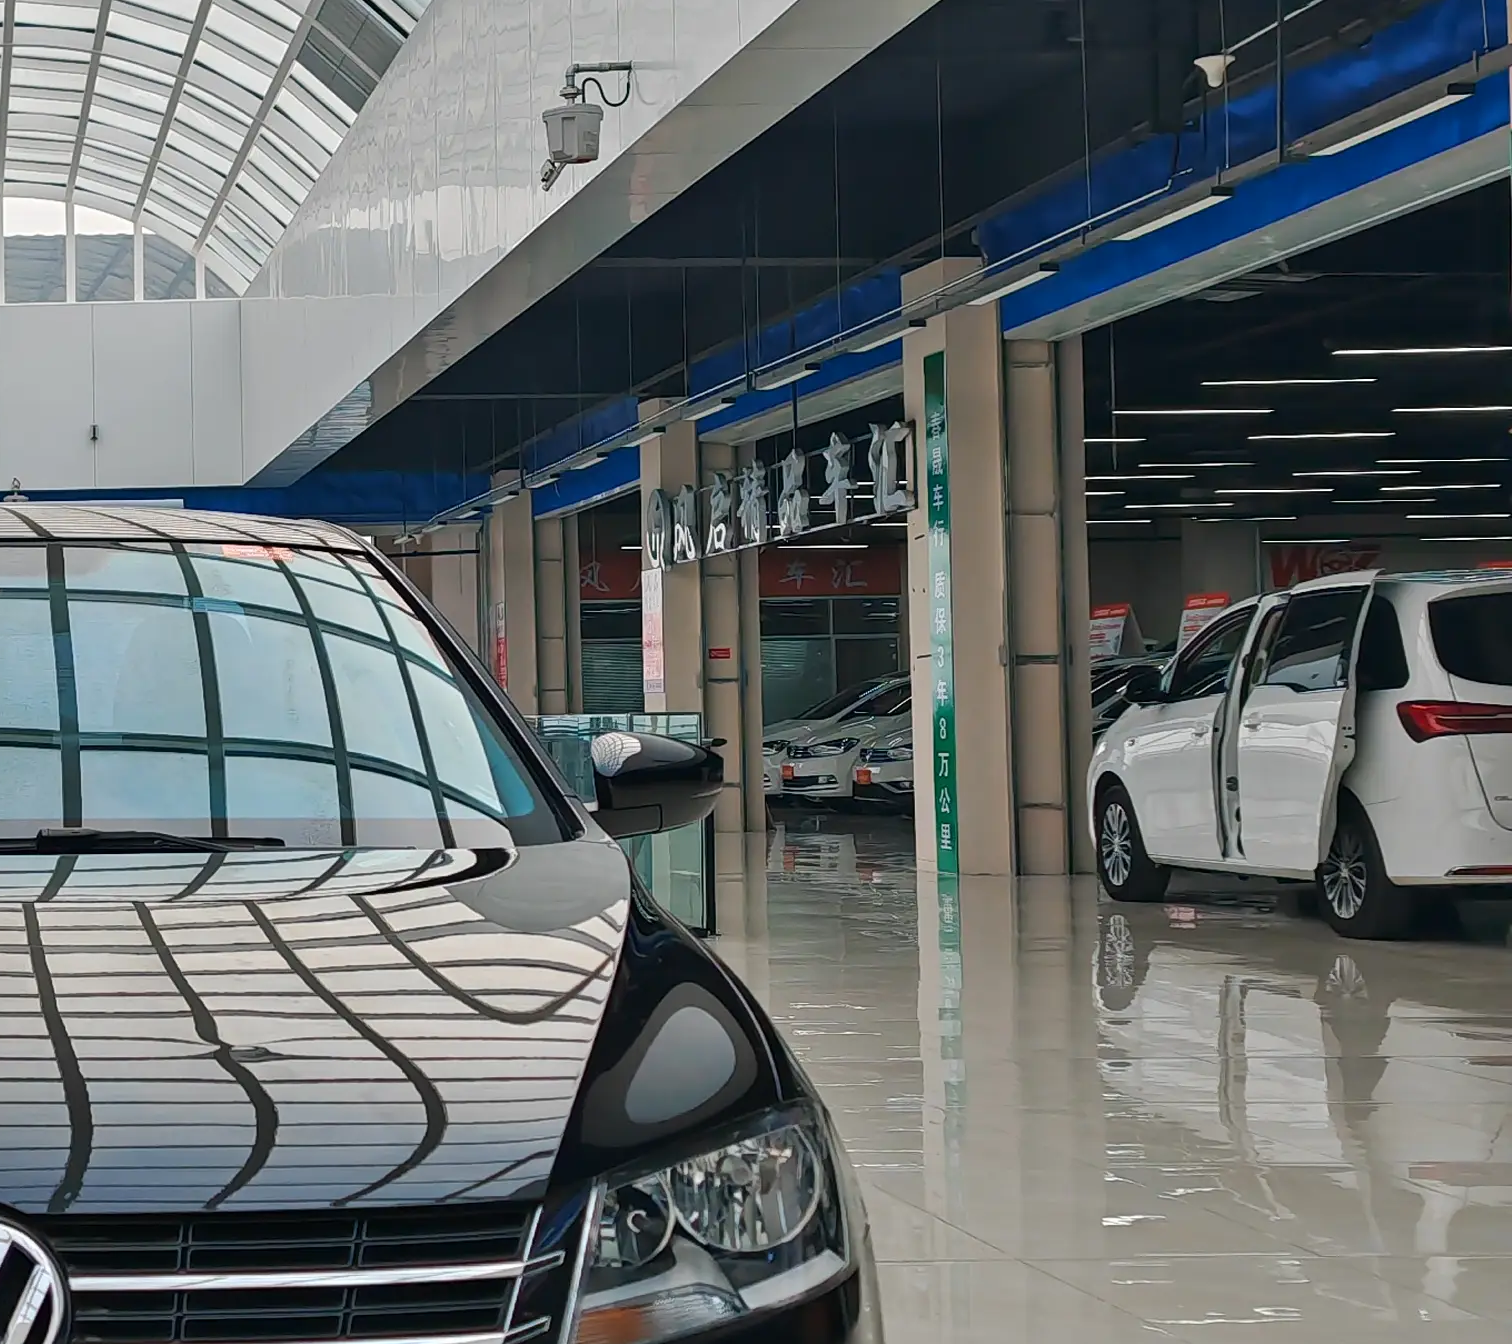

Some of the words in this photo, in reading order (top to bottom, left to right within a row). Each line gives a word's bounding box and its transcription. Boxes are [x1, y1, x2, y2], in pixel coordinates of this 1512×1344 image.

[934, 571, 953, 851] 质保3年8万公里
